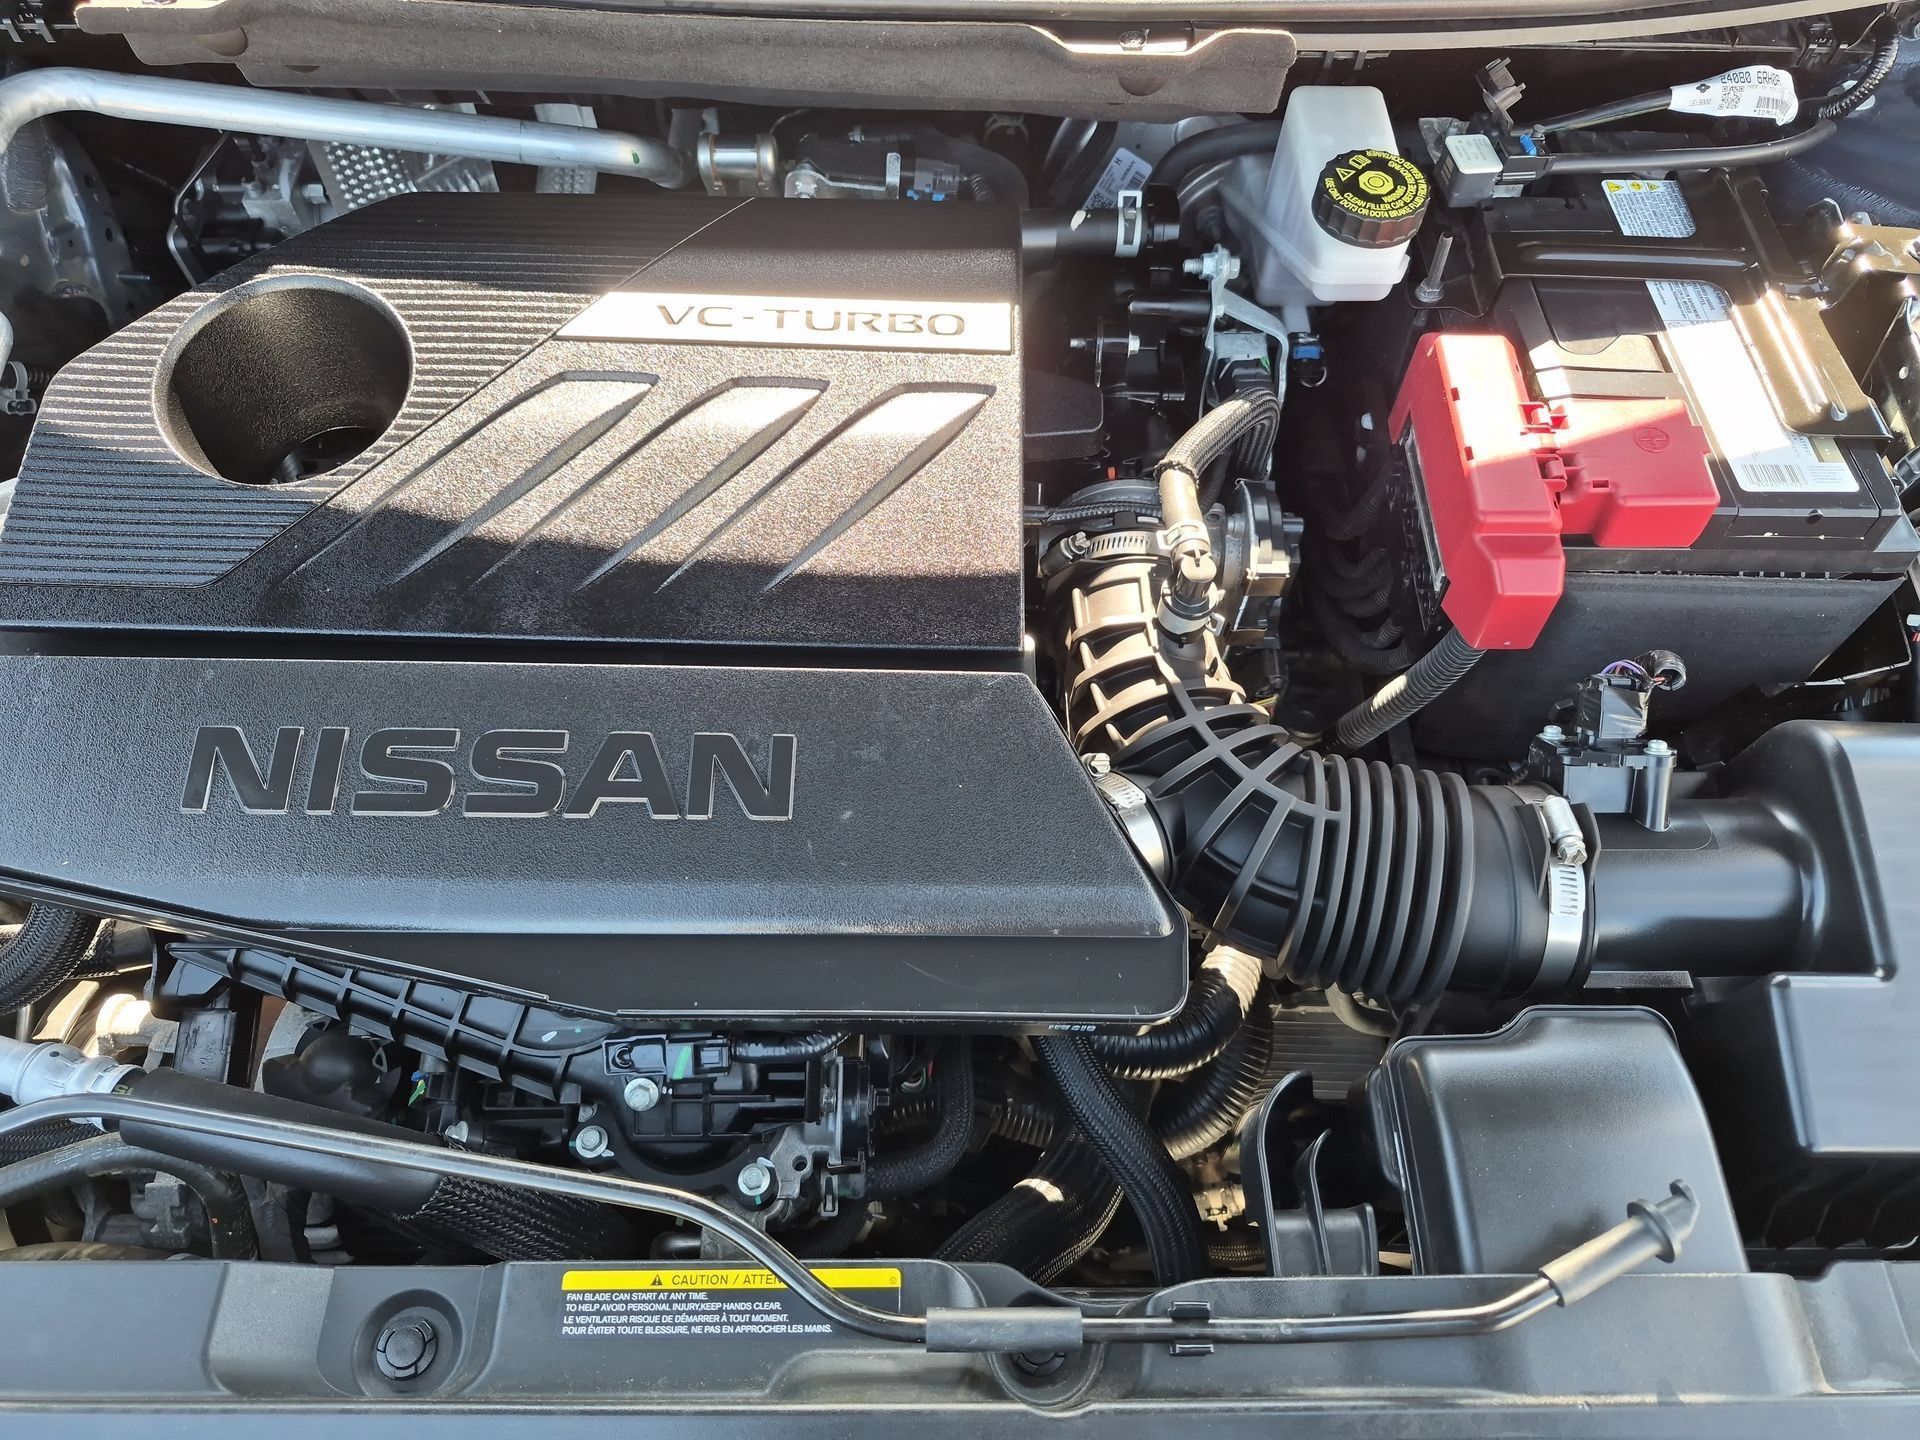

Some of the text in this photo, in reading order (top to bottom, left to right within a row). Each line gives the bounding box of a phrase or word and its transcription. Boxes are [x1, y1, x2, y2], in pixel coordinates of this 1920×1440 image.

[1720, 71, 1752, 84] 24080
[1324, 177, 1335, 188] USE
[1328, 187, 1344, 200] ONLY
[1339, 199, 1358, 212] DOT3
[1343, 192, 1366, 207] CLEAN
[1366, 202, 1392, 211] FILLER
[1391, 199, 1405, 209] CAP
[1357, 207, 1369, 216] OR
[1369, 210, 1389, 218] DOT4
[1389, 205, 1412, 218] BRAKE
[656, 304, 966, 336] VC-TURBO
[180, 726, 797, 821] NISSAN
[672, 1274, 728, 1286] CAUTION
[584, 1292, 611, 1300] BLADE
[612, 1292, 631, 1300] CAN
[631, 1292, 658, 1300] START
[658, 1292, 669, 1300] AT
[669, 1292, 688, 1300] ANY
[688, 1292, 708, 1300] TIME.
[565, 1303, 577, 1311] TO
[578, 1303, 600, 1311] HELP
[600, 1303, 626, 1311] AVOID
[627, 1303, 671, 1311] PERSONAL
[722, 1302, 752, 1310] HANDS
[753, 1302, 782, 1310] CLEAR.
[564, 1312, 789, 1323] LE VENTILATEUR RISQUE DE DÉMARRER À TOUT MOMENT.
[562, 1326, 586, 1334] POUR
[587, 1324, 615, 1334] ÉVITER
[616, 1326, 643, 1334] TOUTE
[644, 1326, 690, 1335] BLESSURE,
[704, 1325, 721, 1333] PAS
[721, 1325, 734, 1333] EN
[734, 1325, 787, 1333] APPROCHER
[787, 1325, 803, 1333] LES
[804, 1324, 833, 1333] MAINS.
